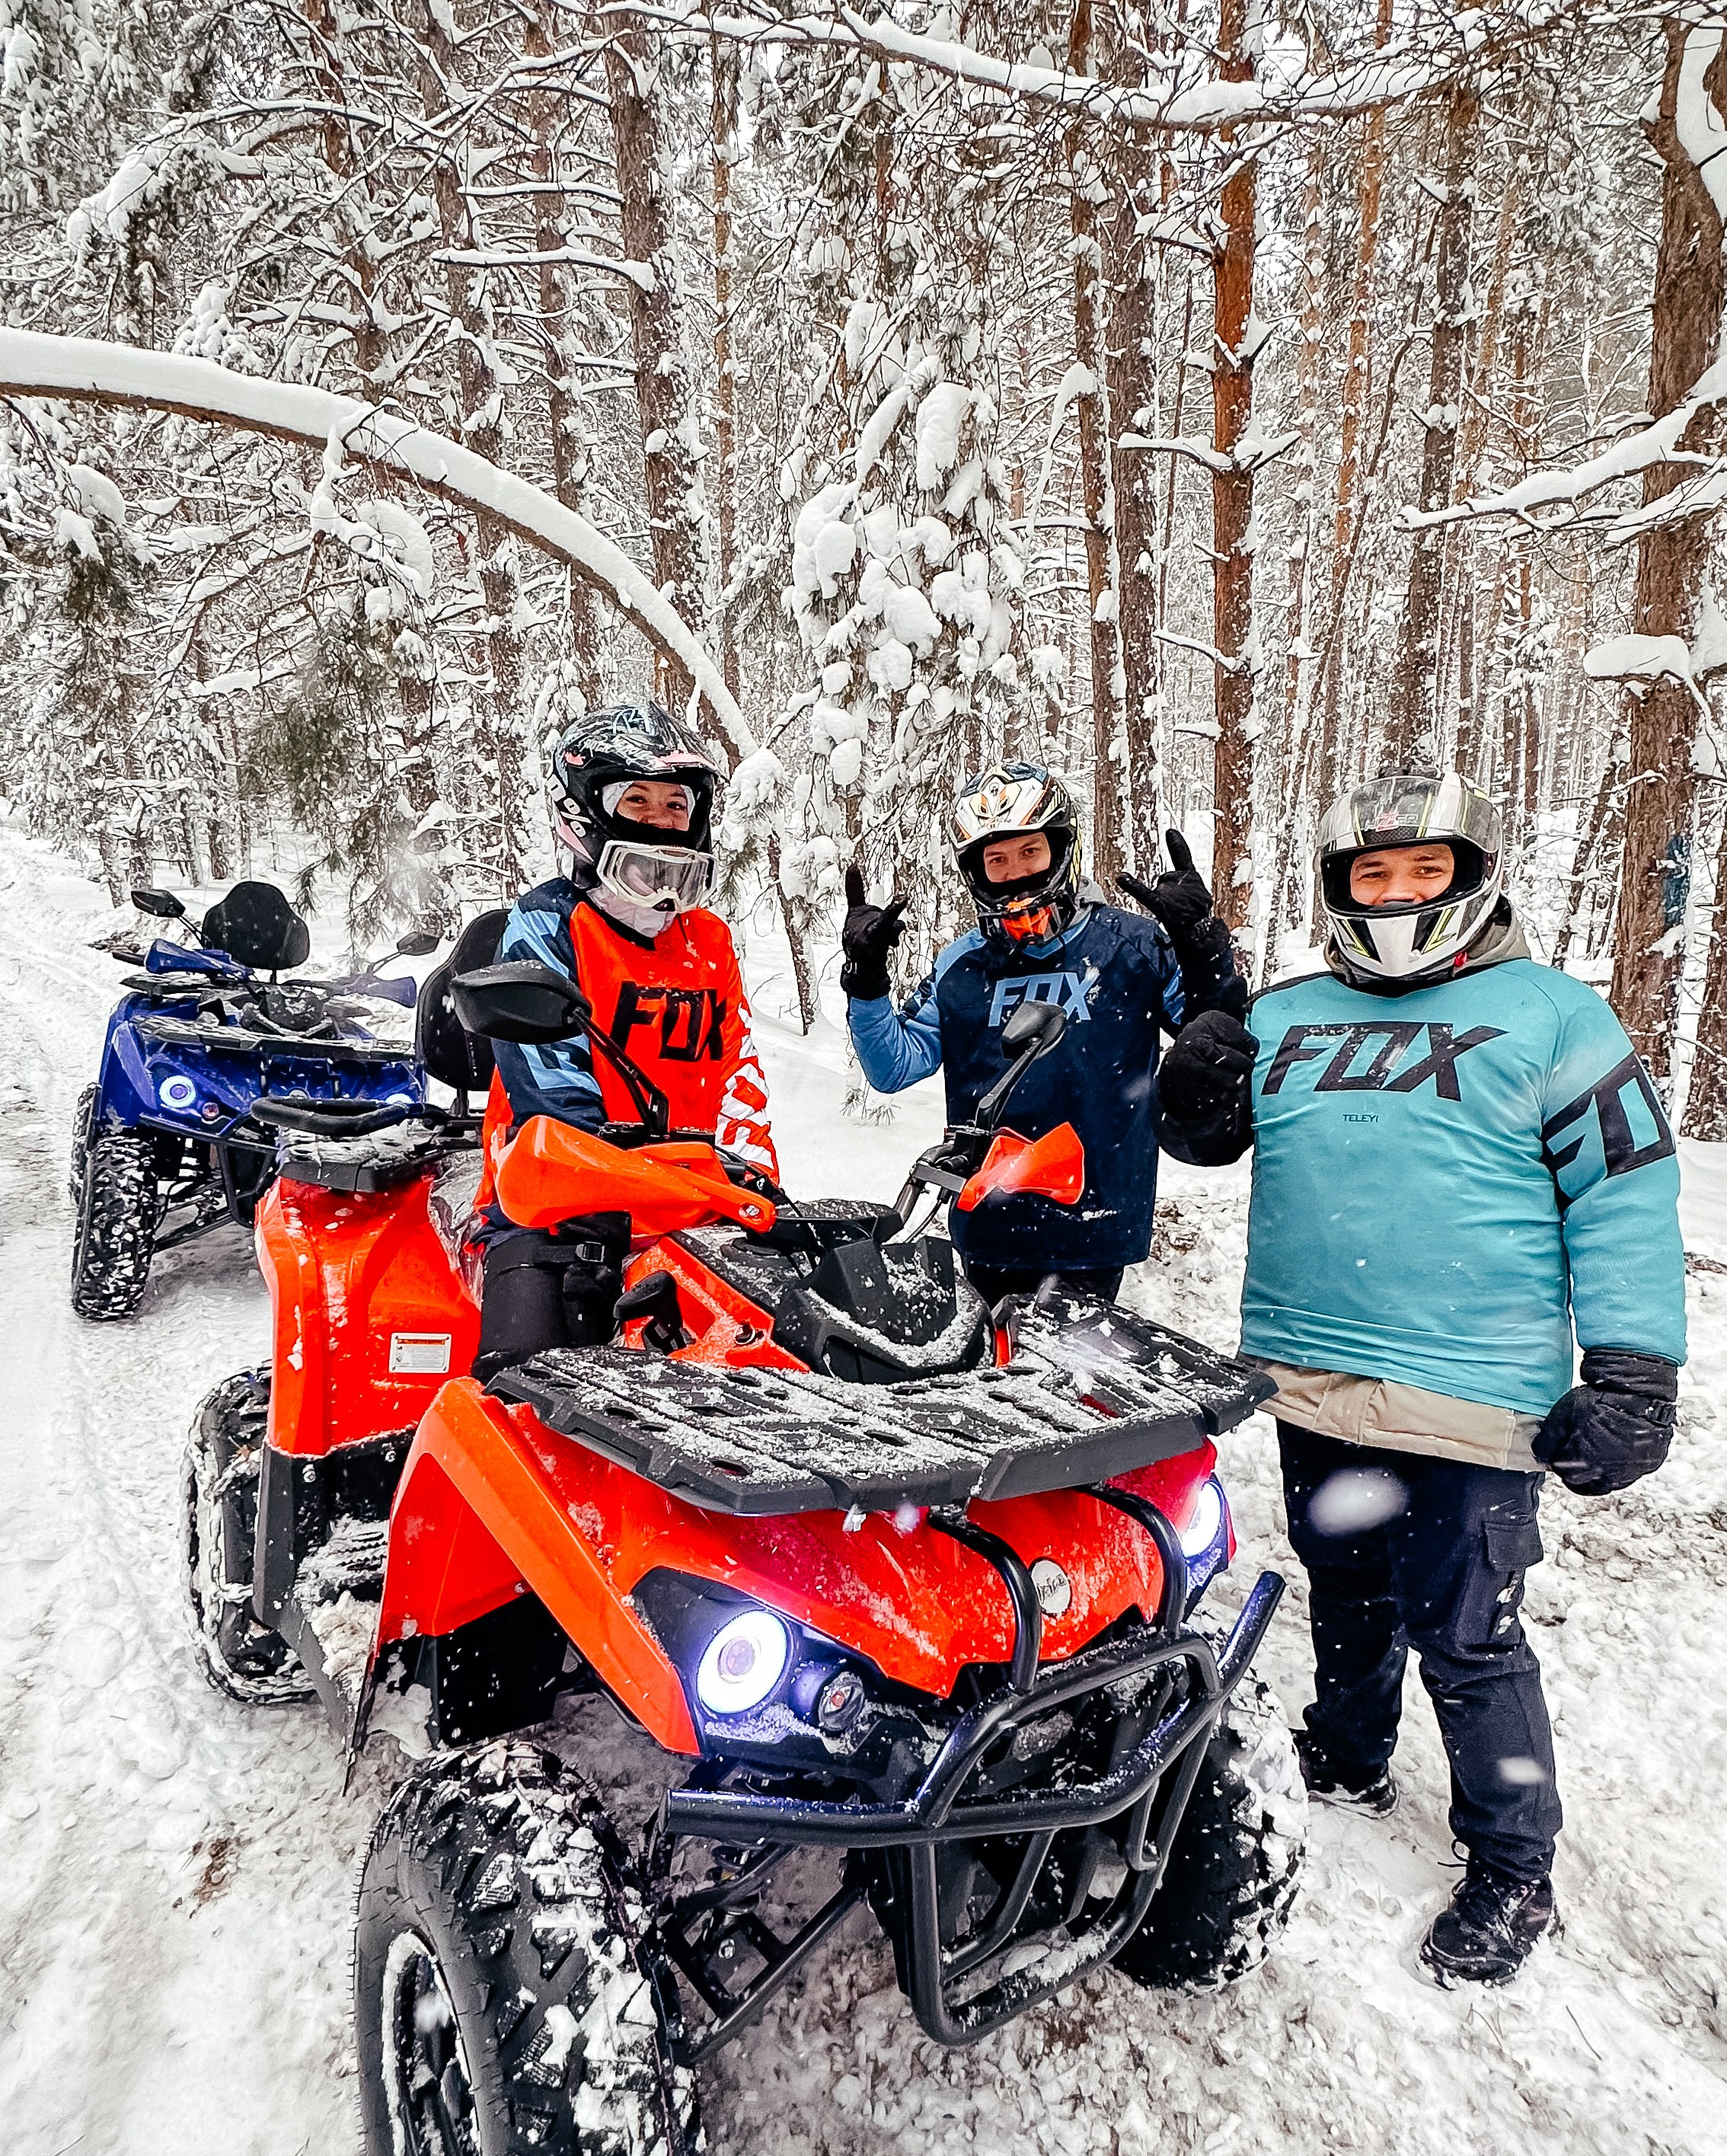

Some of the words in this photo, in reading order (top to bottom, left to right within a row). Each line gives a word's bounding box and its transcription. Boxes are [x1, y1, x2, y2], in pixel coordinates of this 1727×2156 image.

[610, 979, 727, 1062] FOX
[988, 973, 1100, 1027] FOX
[1260, 1021, 1510, 1103] FOX
[1541, 1052, 1675, 1211] FO
